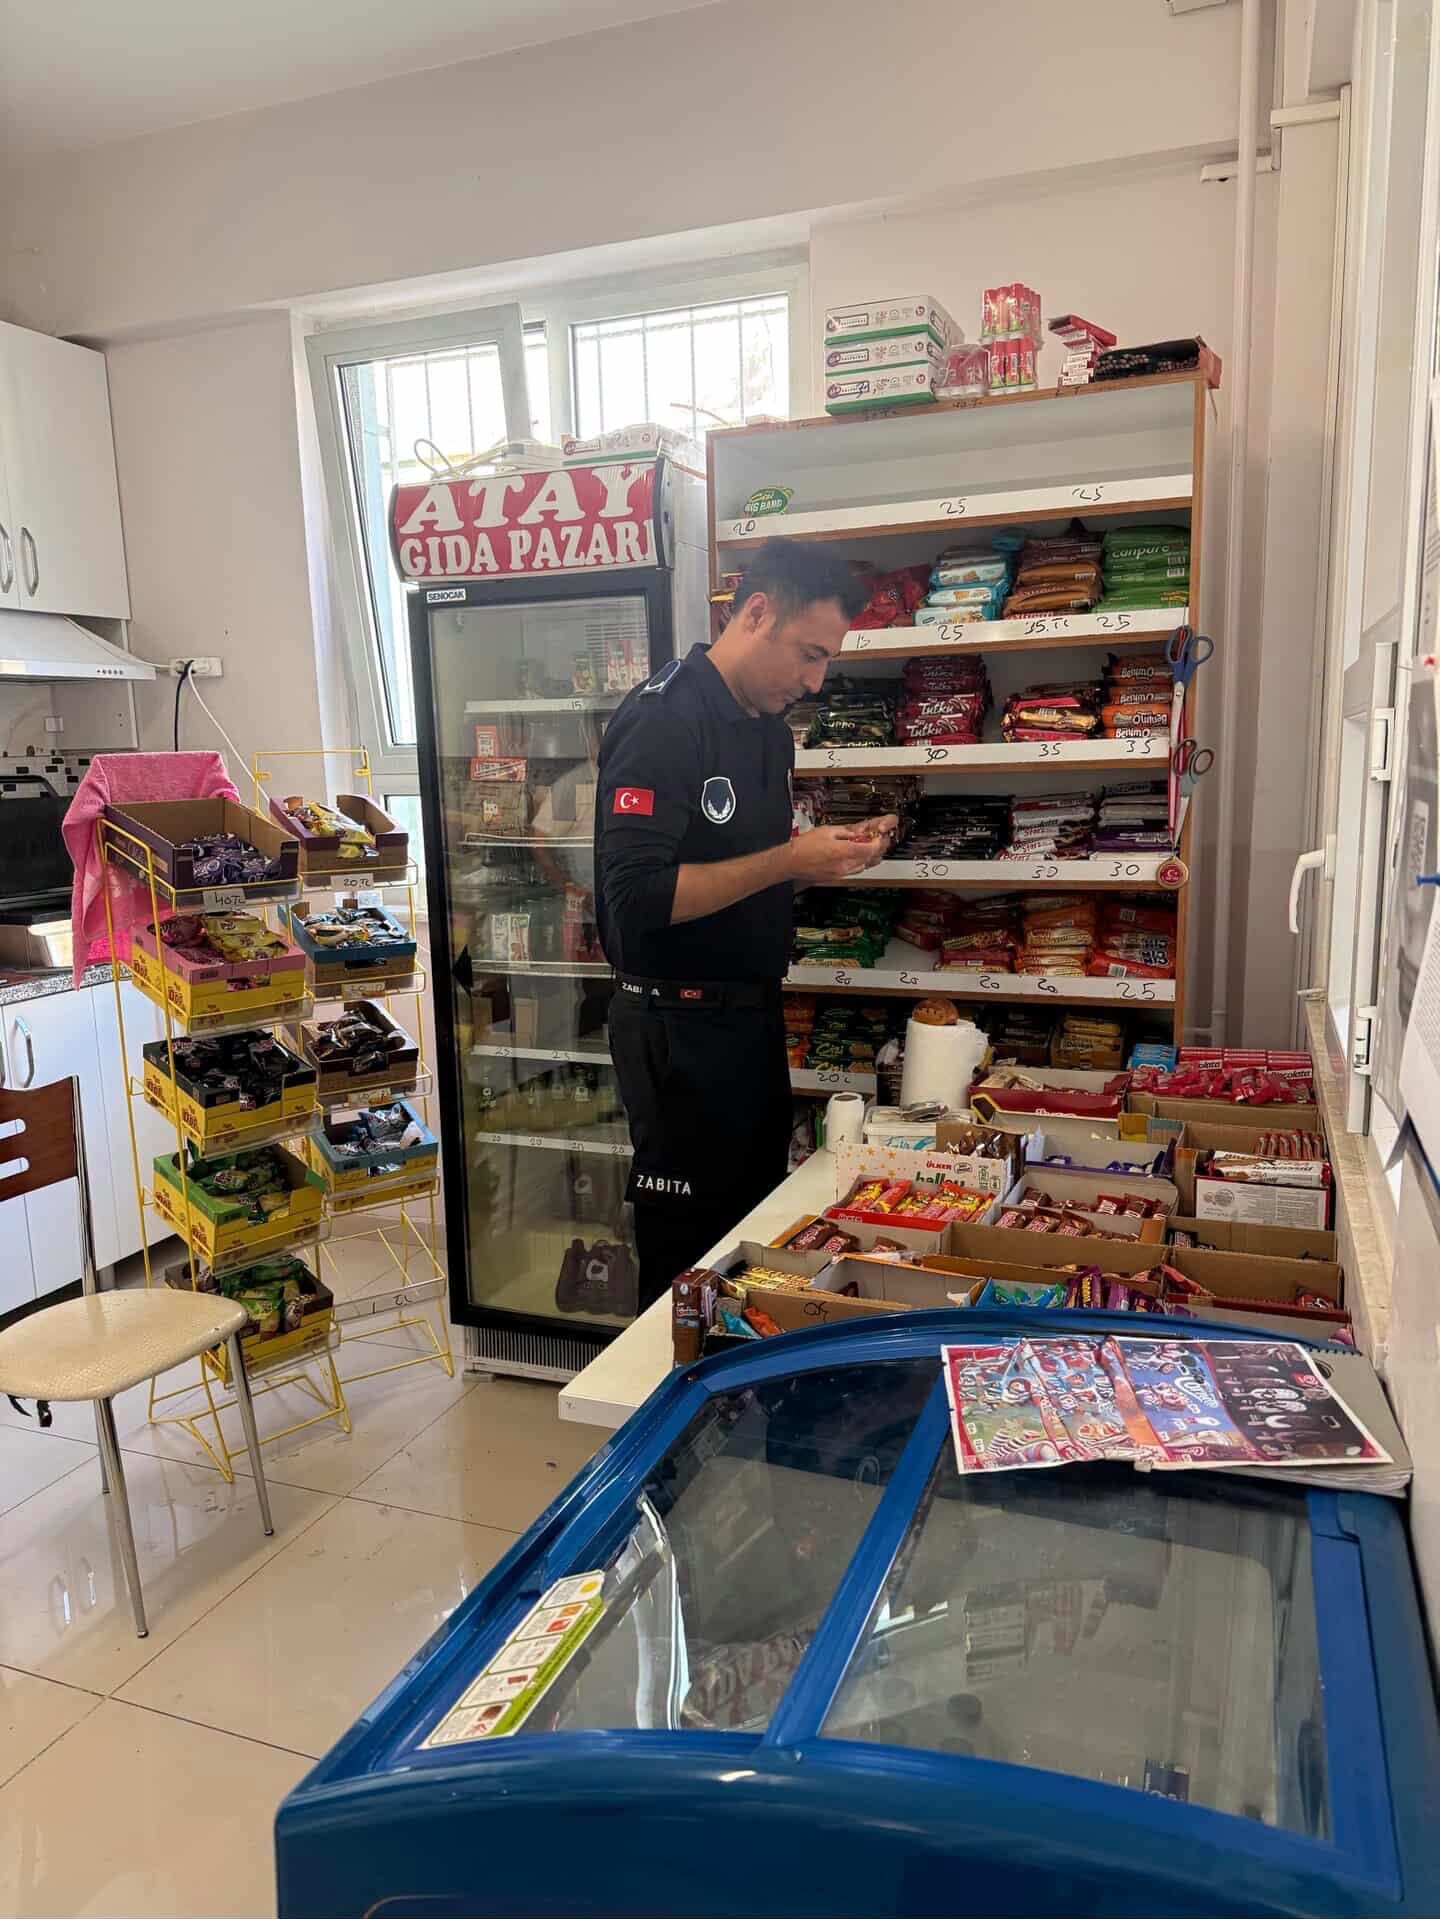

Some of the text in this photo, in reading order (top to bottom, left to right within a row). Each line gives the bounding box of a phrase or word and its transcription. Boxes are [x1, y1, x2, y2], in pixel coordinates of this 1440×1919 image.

[401, 463, 656, 533] ATAY
[1072, 486, 1104, 501] 25
[939, 499, 967, 514] 25
[733, 519, 756, 535] 20
[401, 533, 499, 576] GIDA
[1097, 615, 1132, 631] 25
[938, 624, 964, 641] 25
[918, 700, 953, 715] Tutku
[906, 722, 943, 737] Tutku
[1038, 742, 1062, 758] 35
[1126, 737, 1158, 754] 35
[924, 747, 949, 763] 30
[914, 862, 949, 878] 30
[1031, 865, 1058, 879] 30
[1110, 861, 1140, 877] 30
[834, 970, 852, 985] 20
[900, 972, 920, 985] 20
[980, 975, 1000, 989] 20
[1038, 978, 1058, 993] 20
[1116, 982, 1156, 1000] 25
[637, 1174, 692, 1195] ZABITA
